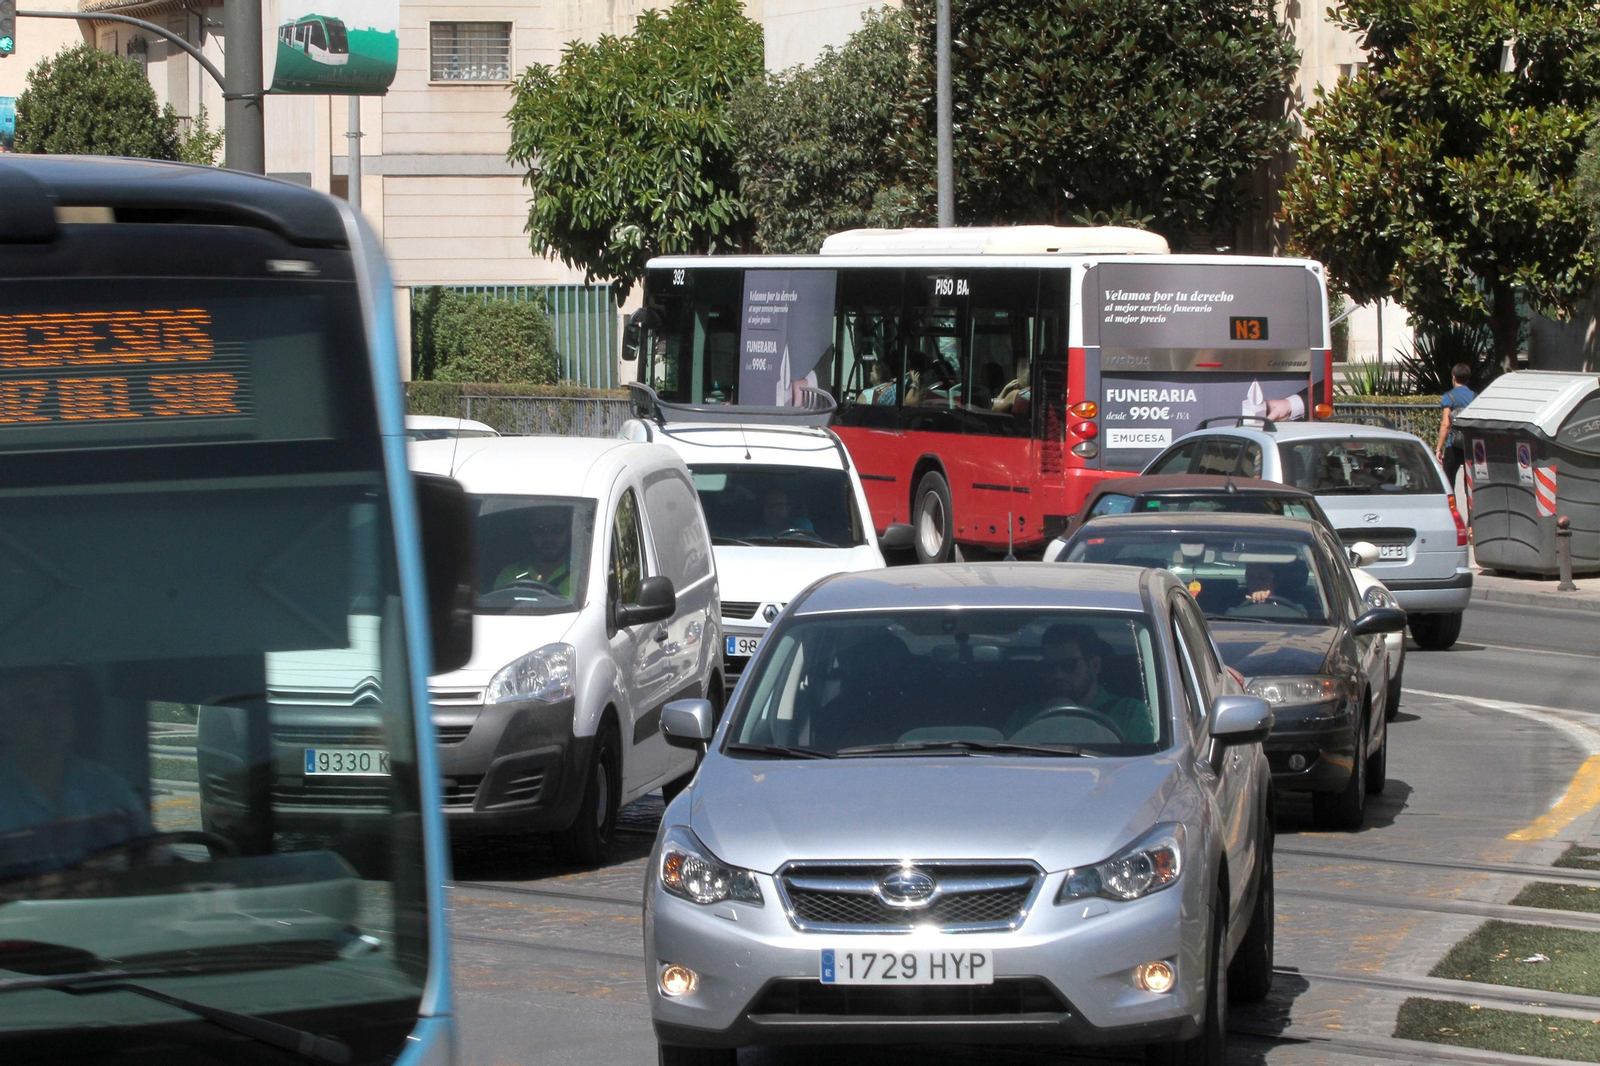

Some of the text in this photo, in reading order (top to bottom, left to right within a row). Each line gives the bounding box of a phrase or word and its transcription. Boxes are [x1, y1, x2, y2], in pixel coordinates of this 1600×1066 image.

[673, 269, 685, 285] 392
[935, 279, 954, 295] PISO
[1105, 289, 1234, 303] Velamos por tu derecho
[1104, 303, 1212, 313] al mejor servicio funerario
[1104, 314, 1166, 324] al mejor precio
[1236, 320, 1260, 340] N3
[746, 341, 777, 353] FUNERARIA
[752, 358, 767, 371] 990€
[1267, 359, 1307, 367] Castrosua
[1106, 389, 1197, 402] FUNERARIA
[1106, 411, 1127, 420] desde
[1129, 406, 1170, 420] 990€
[1176, 412, 1190, 420] IVA
[1113, 434, 1166, 442] EMUCESA
[1381, 544, 1403, 556] CFB
[739, 640, 757, 653] 98
[319, 753, 371, 771] 9330
[825, 953, 986, 979] E 1729 HYP
